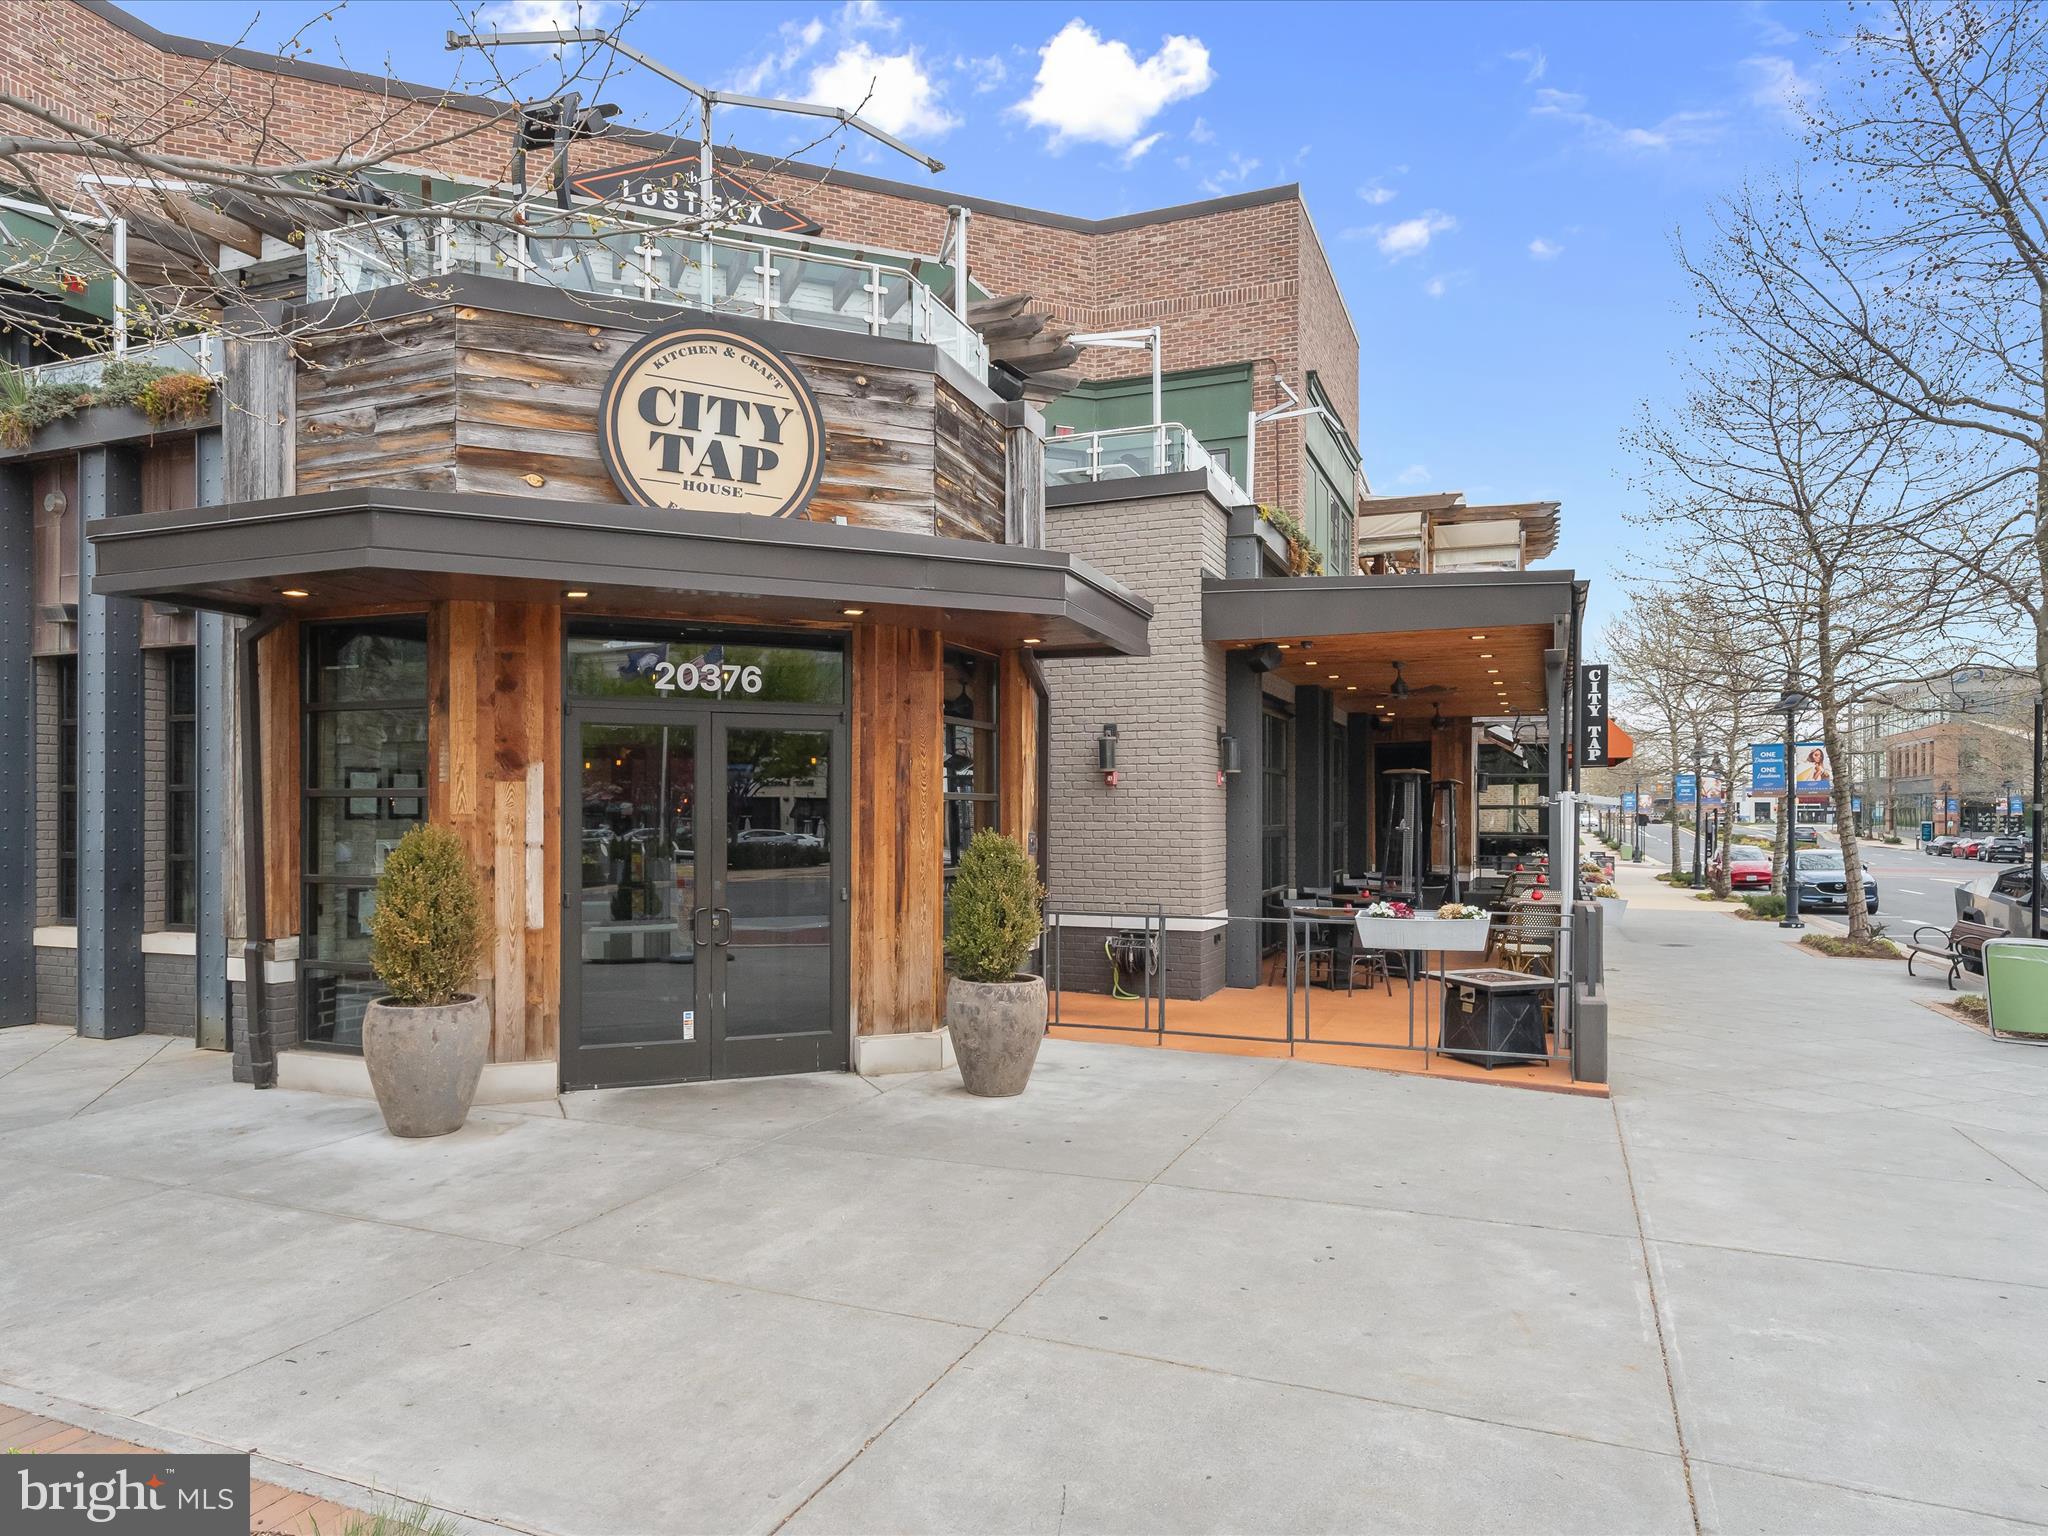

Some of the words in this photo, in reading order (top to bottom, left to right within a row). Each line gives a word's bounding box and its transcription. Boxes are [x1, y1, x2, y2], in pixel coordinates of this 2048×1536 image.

[623, 179, 699, 213] LOST
[652, 345, 719, 371] KITCHEN
[723, 347, 736, 359] &
[740, 354, 784, 391] CRAFT
[637, 385, 794, 446] CITY
[649, 430, 780, 485] TAP
[682, 479, 743, 498] HOUSE
[654, 662, 763, 693] 20376
[1587, 669, 1602, 717] CITY
[1587, 726, 1602, 761] TAP
